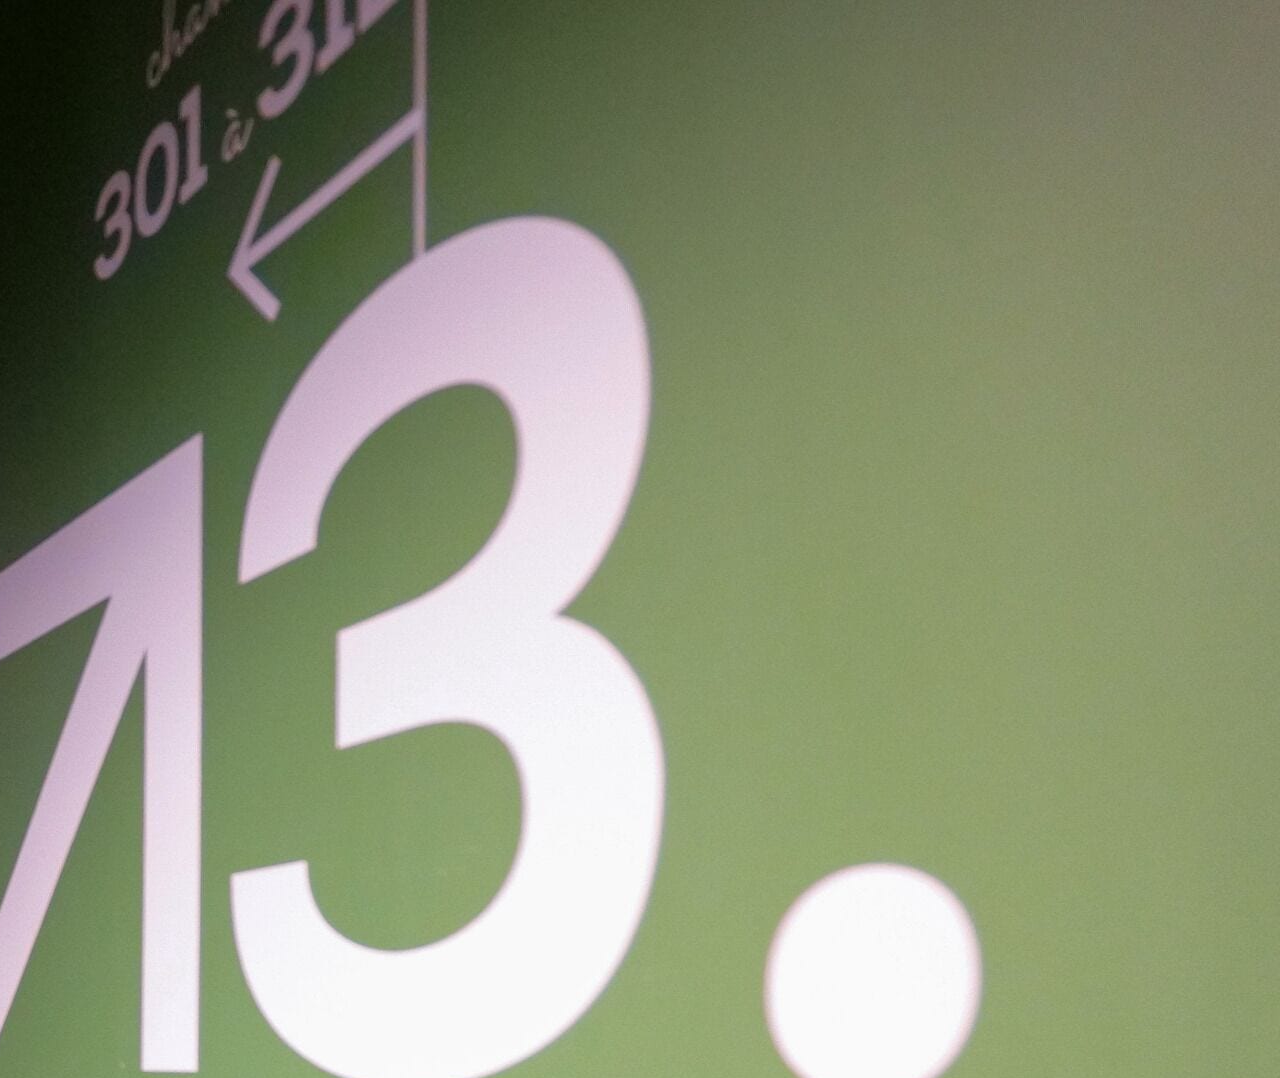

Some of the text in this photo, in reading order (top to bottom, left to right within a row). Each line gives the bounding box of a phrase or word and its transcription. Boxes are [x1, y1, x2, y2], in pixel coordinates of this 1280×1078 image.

[93, 0, 397, 280] 301 à 31
